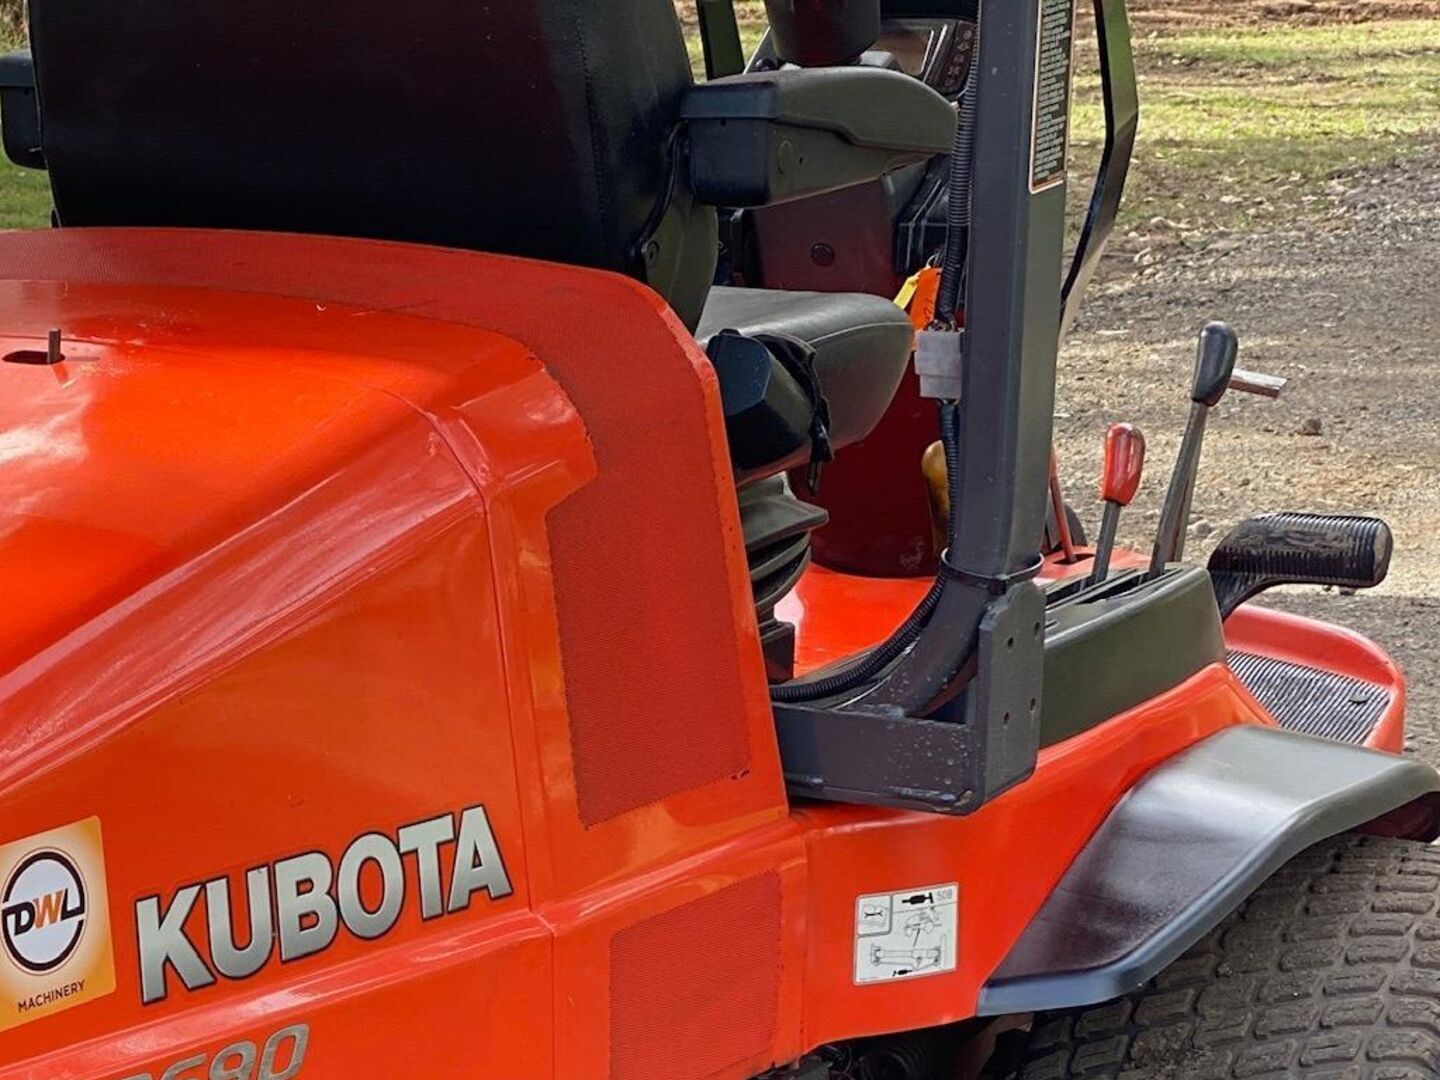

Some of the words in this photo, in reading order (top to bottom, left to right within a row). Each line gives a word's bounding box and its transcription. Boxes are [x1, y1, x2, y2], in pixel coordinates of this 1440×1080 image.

[2, 888, 85, 936] DWL
[136, 804, 513, 1006] KUBOTA
[17, 979, 85, 1013] MACHINERY
